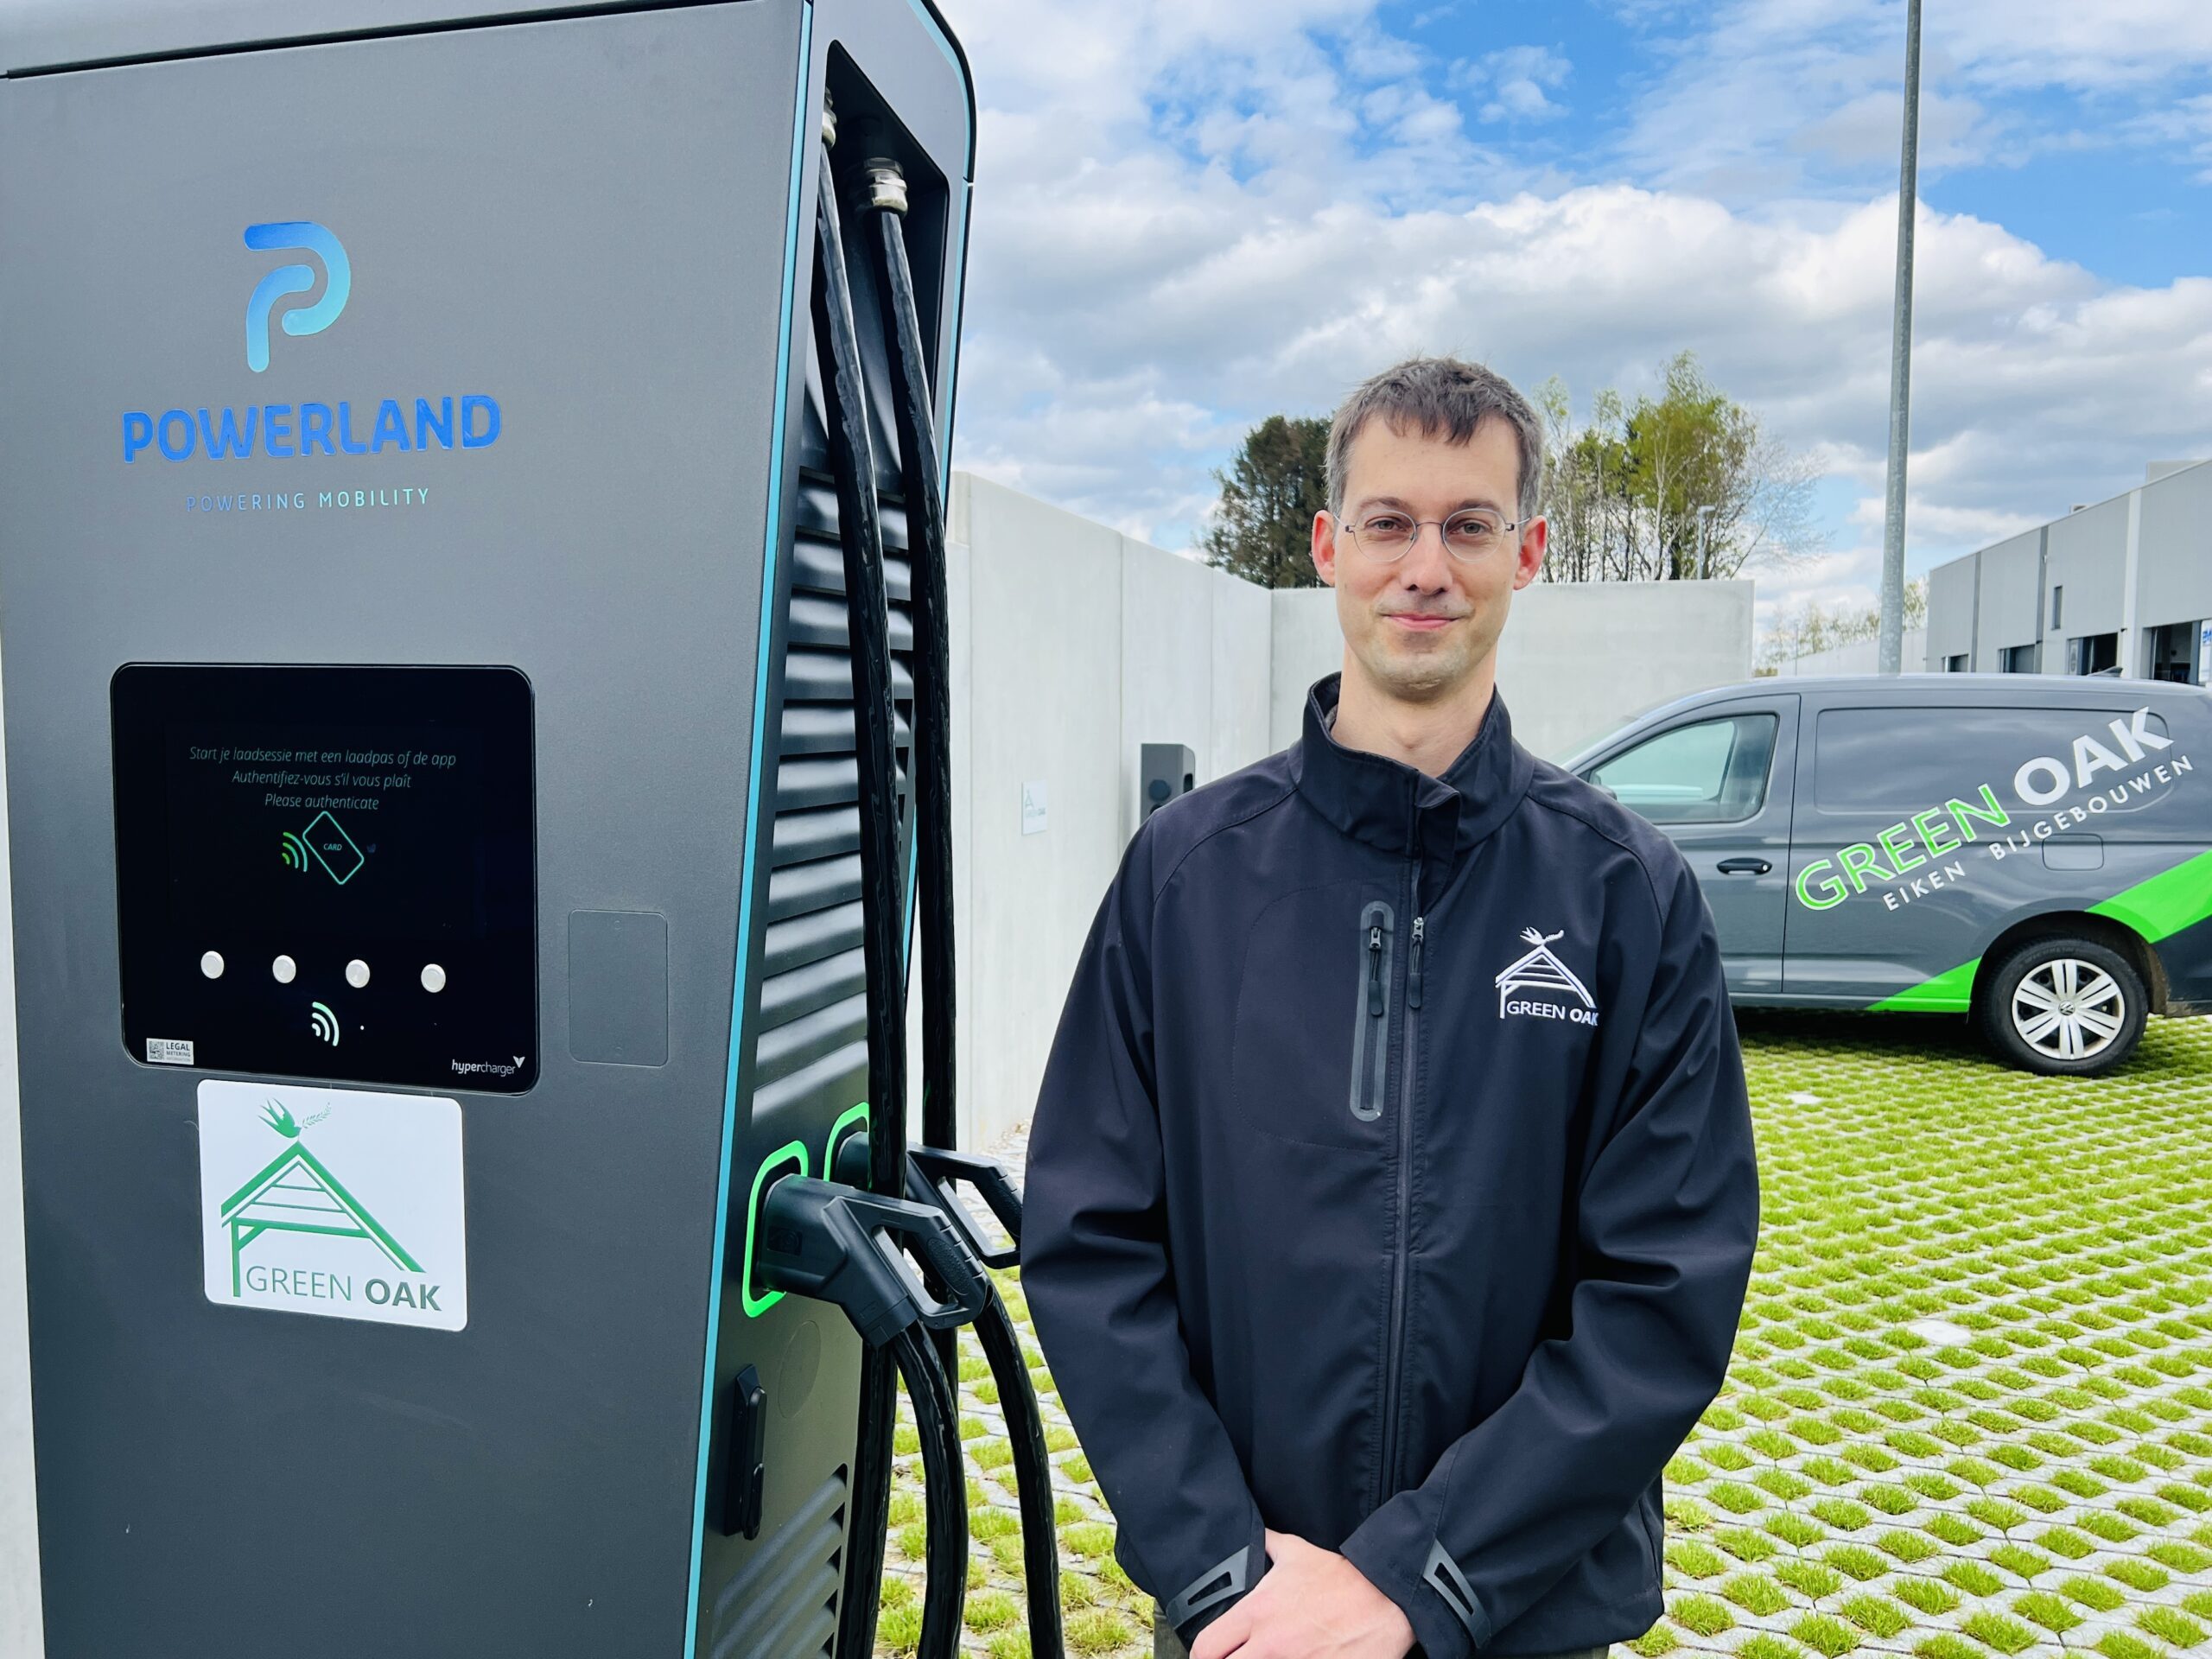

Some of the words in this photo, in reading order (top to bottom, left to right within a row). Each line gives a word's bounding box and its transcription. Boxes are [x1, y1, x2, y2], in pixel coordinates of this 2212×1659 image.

[122, 393, 503, 464] POWERLAND
[186, 493, 305, 512] POWERING
[318, 487, 429, 508] MOBILITY
[189, 746, 218, 760] Start
[218, 747, 231, 765] je
[232, 747, 292, 762] laadsessie
[295, 750, 319, 763] met
[321, 751, 342, 764] een
[345, 748, 394, 767] laadpas
[397, 750, 412, 769] of
[412, 751, 429, 766] de
[431, 753, 456, 770] app
[232, 770, 332, 788] Authentifiez-vous
[353, 775, 381, 787] vous
[383, 772, 412, 791] plaît
[264, 792, 302, 807] Please
[304, 794, 379, 810] authenticate
[1795, 782, 2012, 912] GREEN
[2013, 705, 2176, 806] OAK
[1883, 860, 1966, 912] EIKEN
[1988, 753, 2194, 861] BIJGEBOUWEN
[323, 842, 343, 851] CARD
[1506, 1000, 1566, 1020] GREEN
[1569, 1007, 1599, 1027] OAK
[166, 1042, 190, 1052] LEGAL
[451, 1058, 516, 1077] hypercharger
[245, 1265, 353, 1301] GREEN
[365, 1277, 442, 1312] OAK
